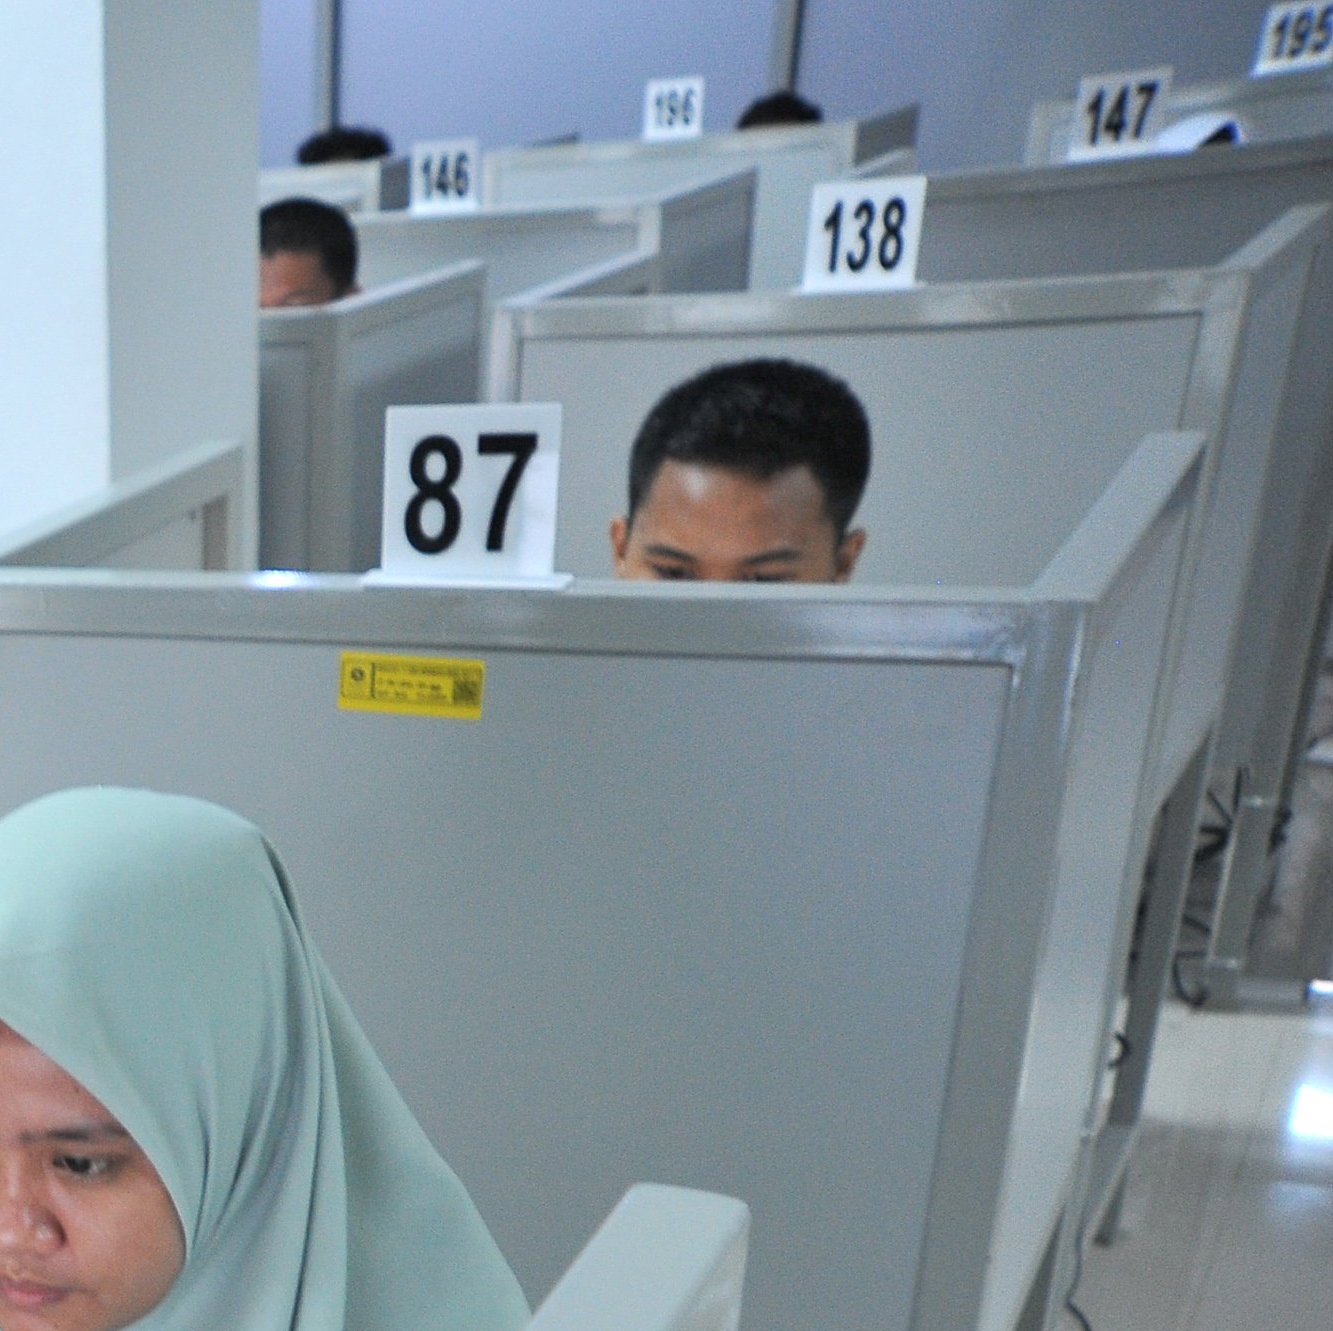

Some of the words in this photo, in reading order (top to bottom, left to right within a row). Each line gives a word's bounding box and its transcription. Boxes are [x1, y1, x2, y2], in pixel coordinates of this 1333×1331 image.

[655, 87, 695, 127] 196
[1087, 80, 1161, 147] 147
[422, 151, 470, 198] 146
[824, 195, 908, 274] 138
[402, 430, 539, 556] 87
